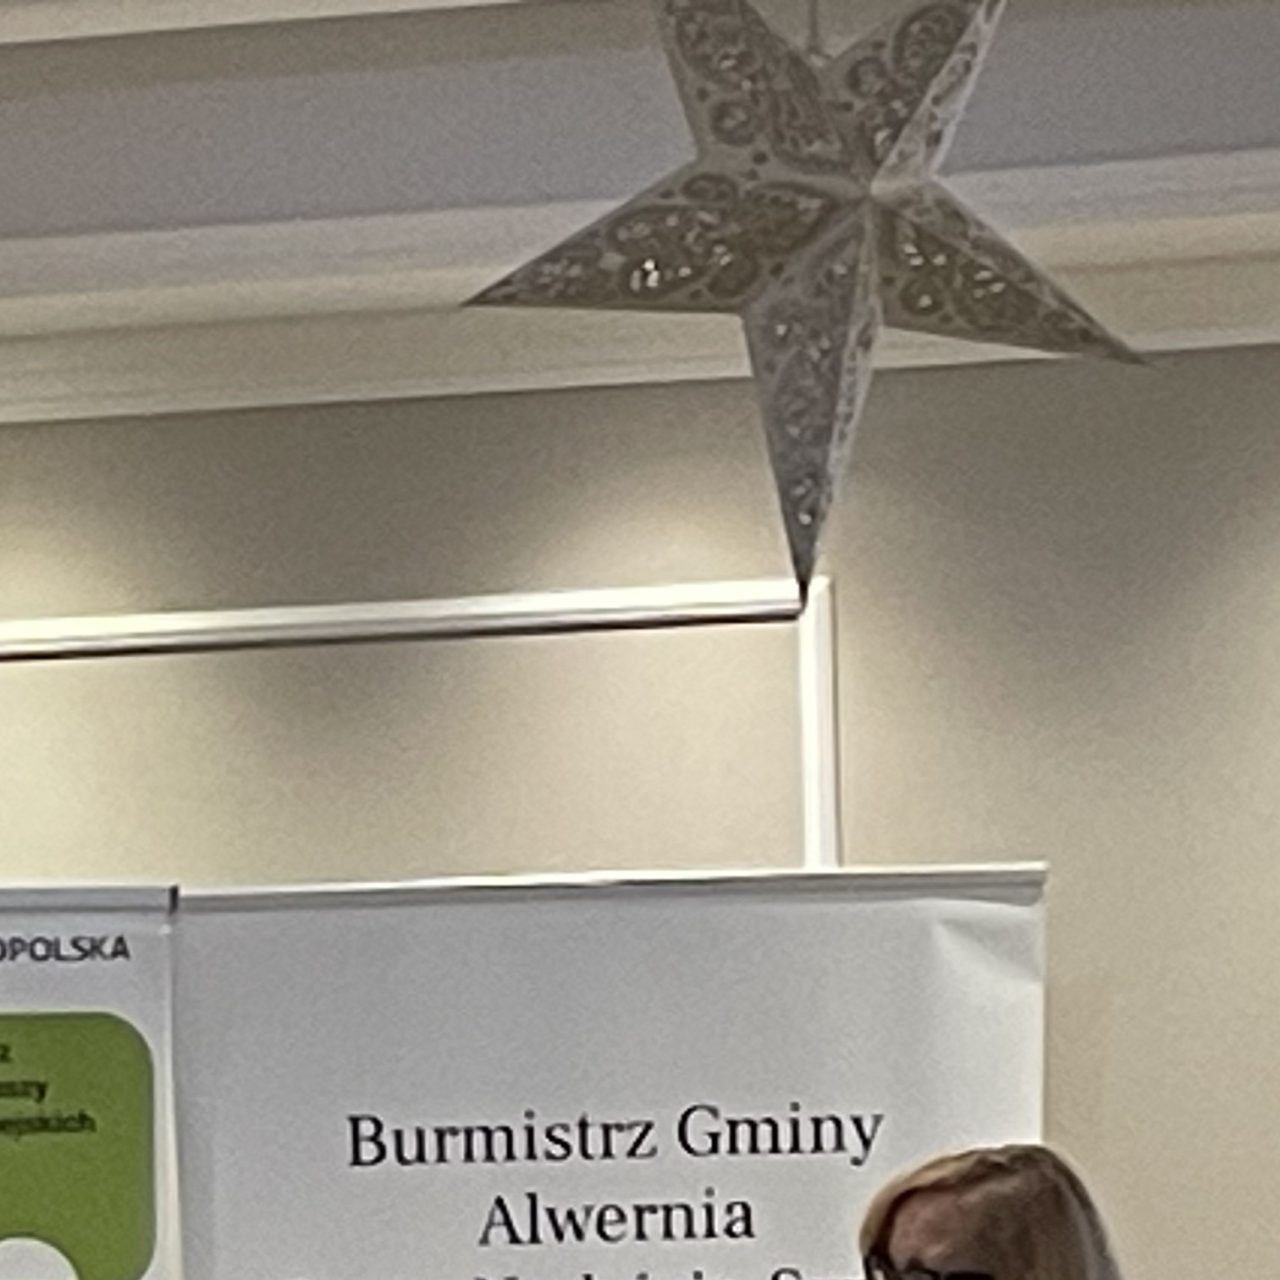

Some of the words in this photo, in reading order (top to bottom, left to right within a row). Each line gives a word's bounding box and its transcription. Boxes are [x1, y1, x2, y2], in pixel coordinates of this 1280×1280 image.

[347, 1109, 658, 1167] Burmistrz
[676, 1101, 884, 1167] Gminy
[477, 1186, 756, 1246] Alwernia
